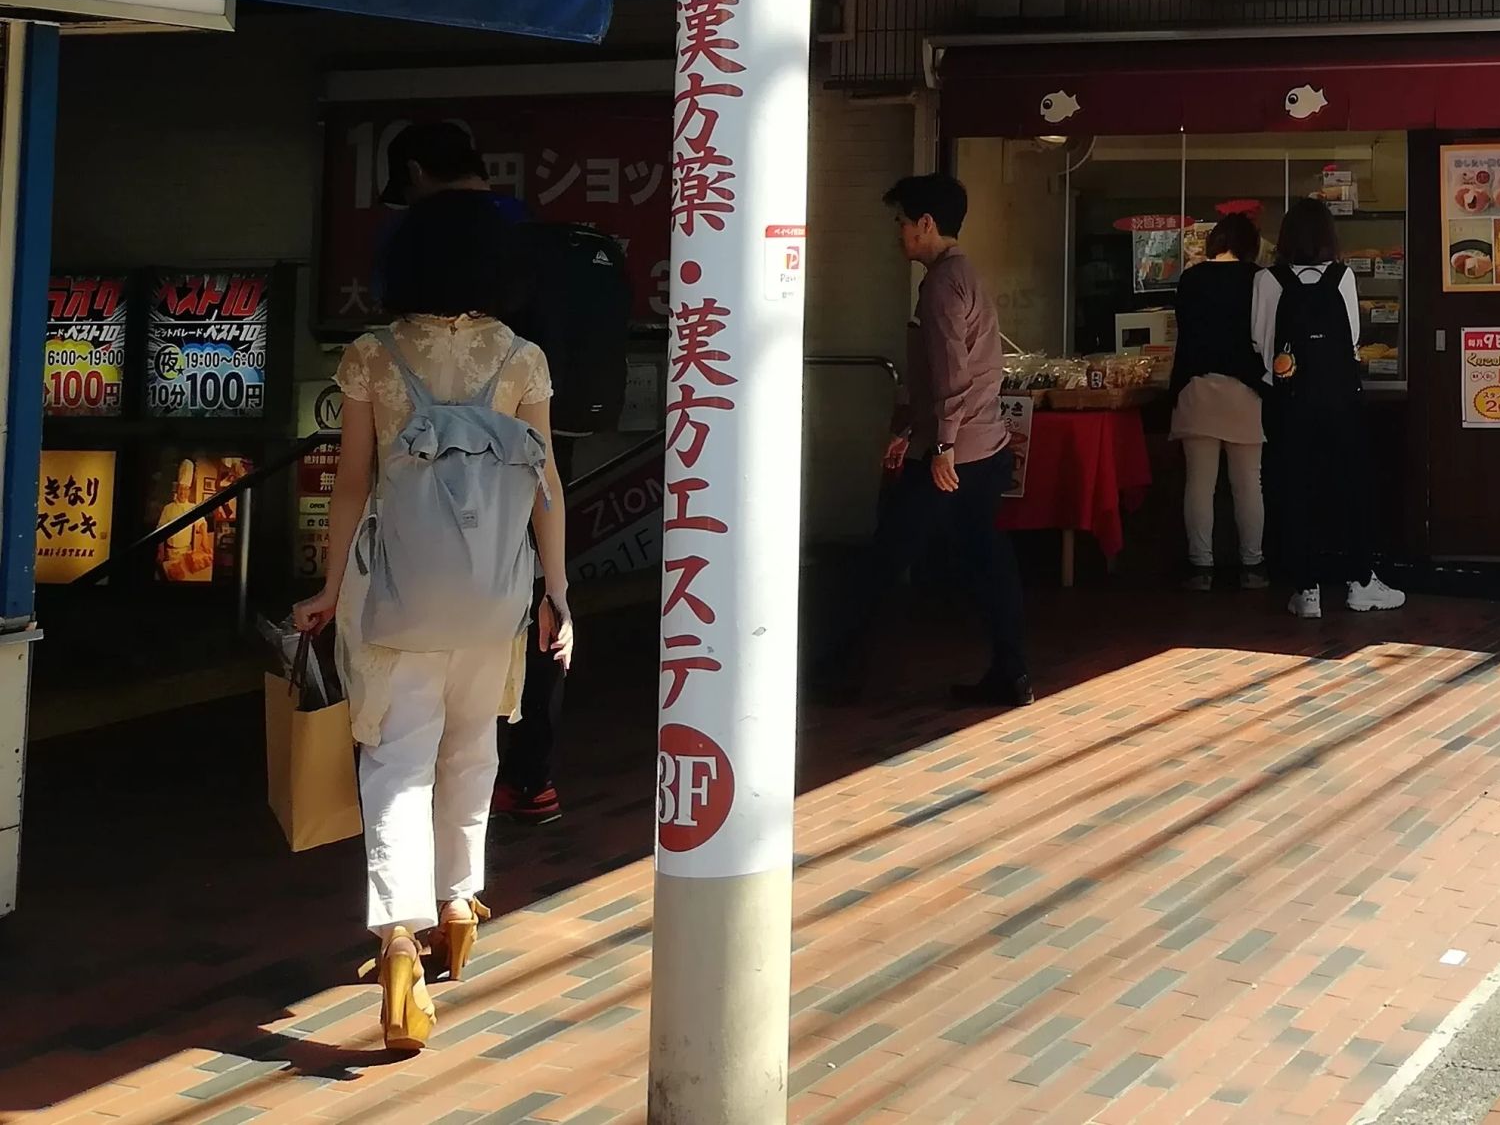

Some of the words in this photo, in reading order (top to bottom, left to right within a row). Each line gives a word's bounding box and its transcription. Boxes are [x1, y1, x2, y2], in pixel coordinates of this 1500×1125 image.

[158, 277, 264, 317] ベスト10
[64, 325, 123, 342] ベスト10
[203, 325, 263, 342] ベスト10
[160, 352, 179, 373] 夜
[36, 512, 97, 539] ステーキ
